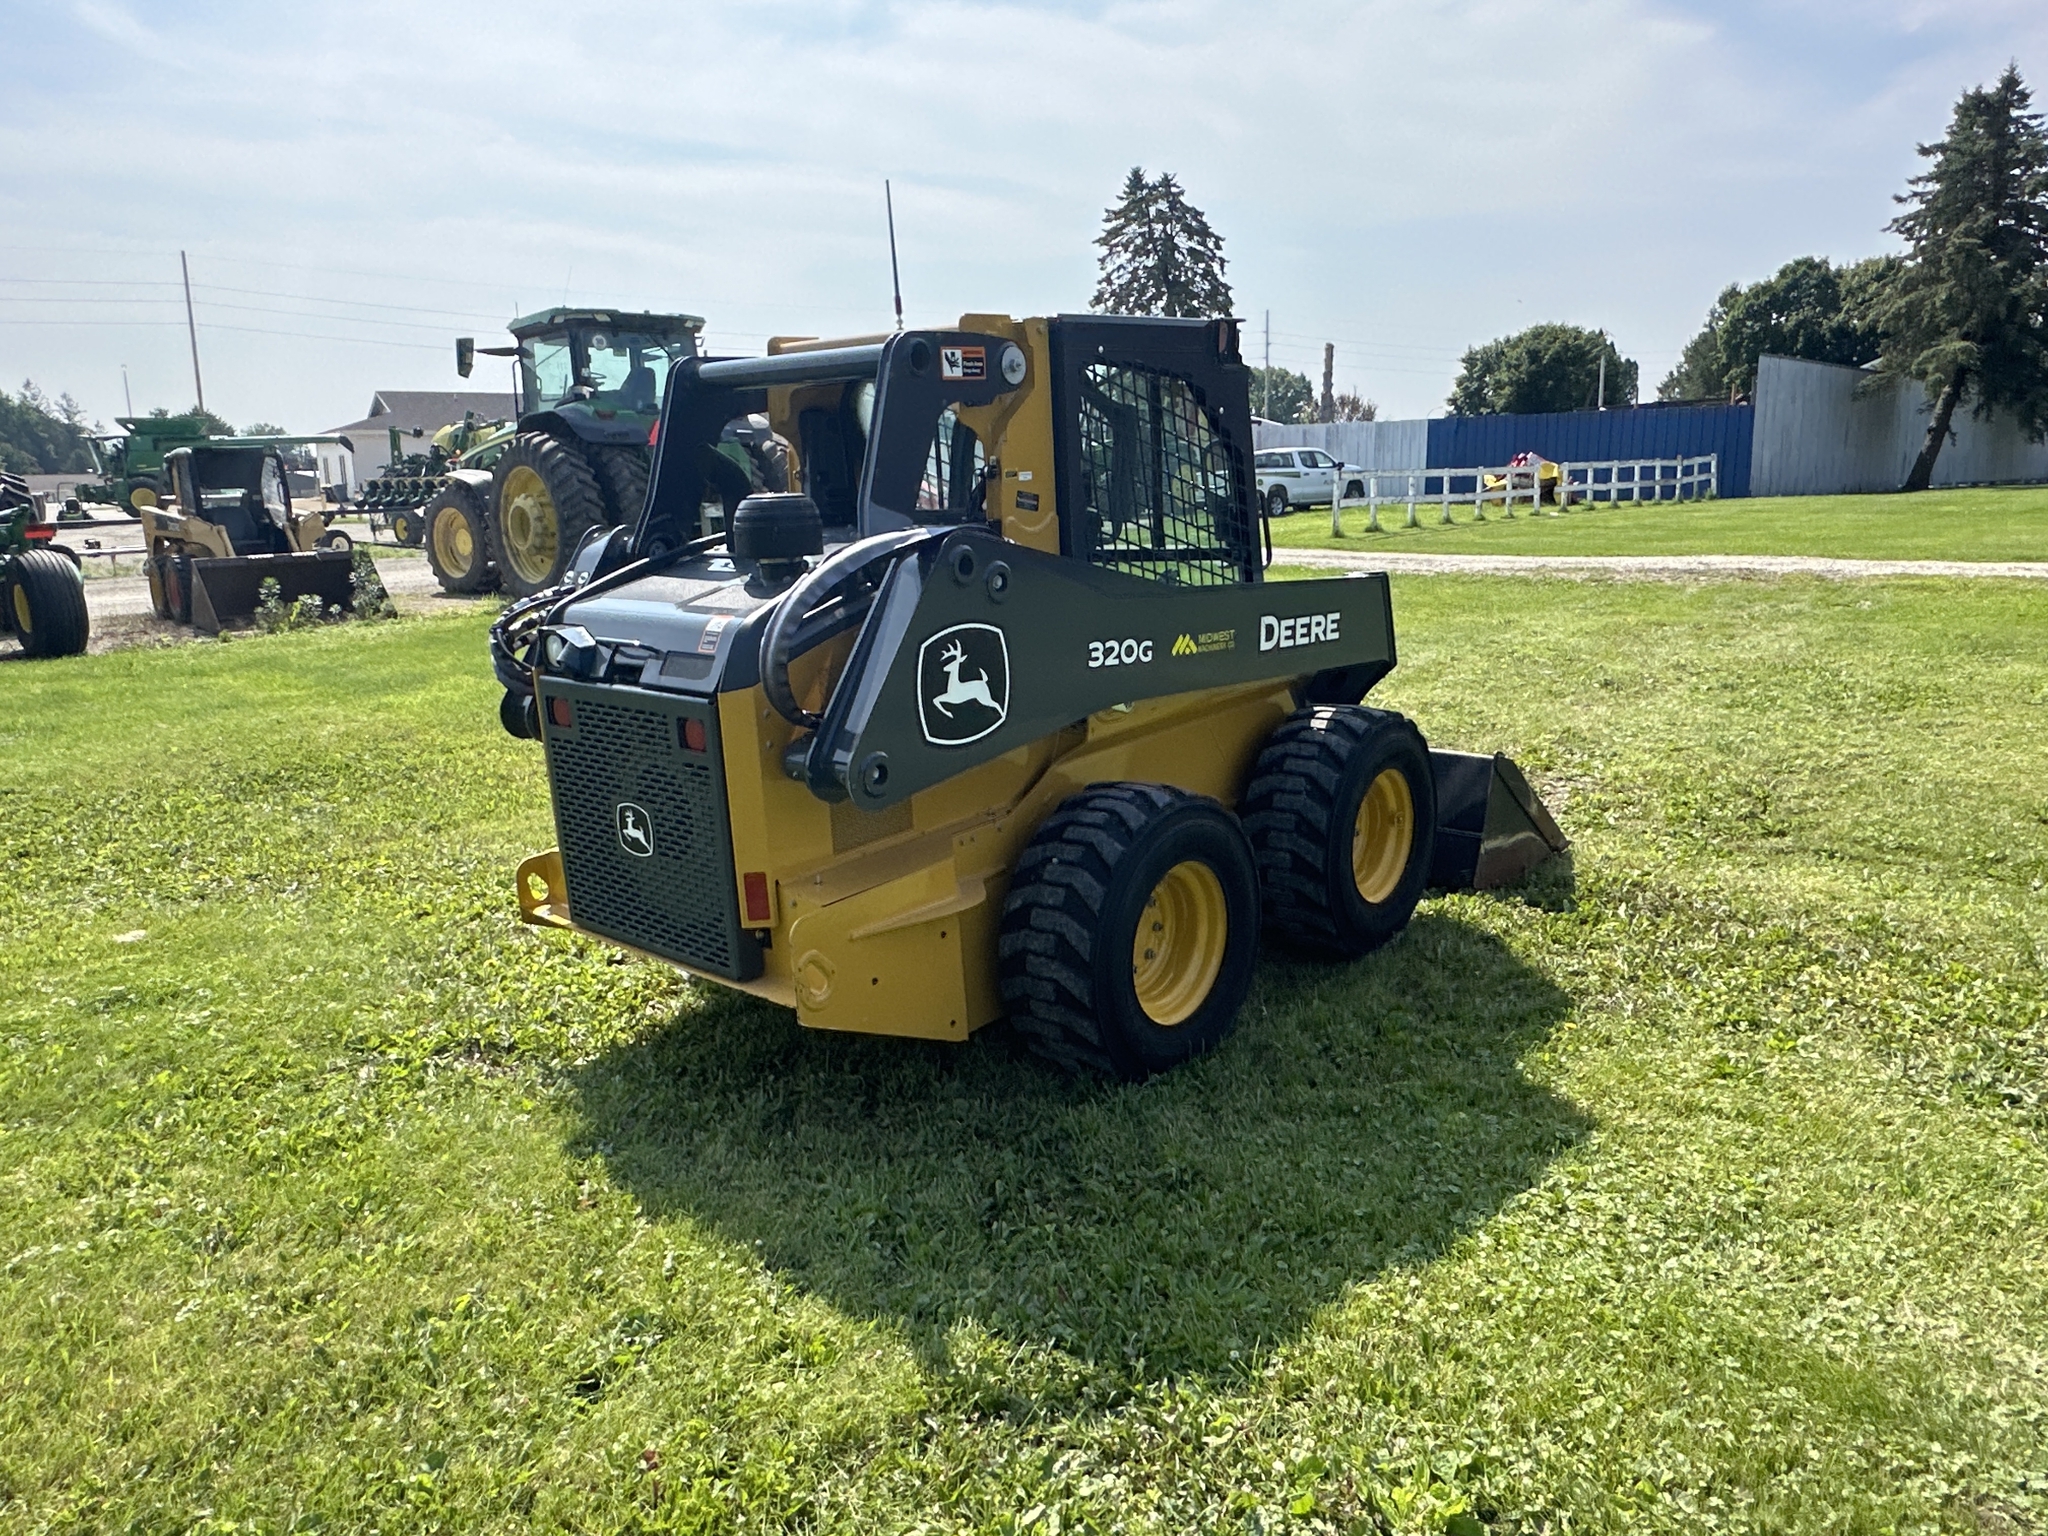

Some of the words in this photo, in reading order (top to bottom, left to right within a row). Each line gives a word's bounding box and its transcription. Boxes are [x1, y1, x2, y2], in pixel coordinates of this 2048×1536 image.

[1198, 629, 1235, 644] MIDWEST
[1259, 612, 1341, 652] DEERE
[1088, 638, 1153, 668] 320G
